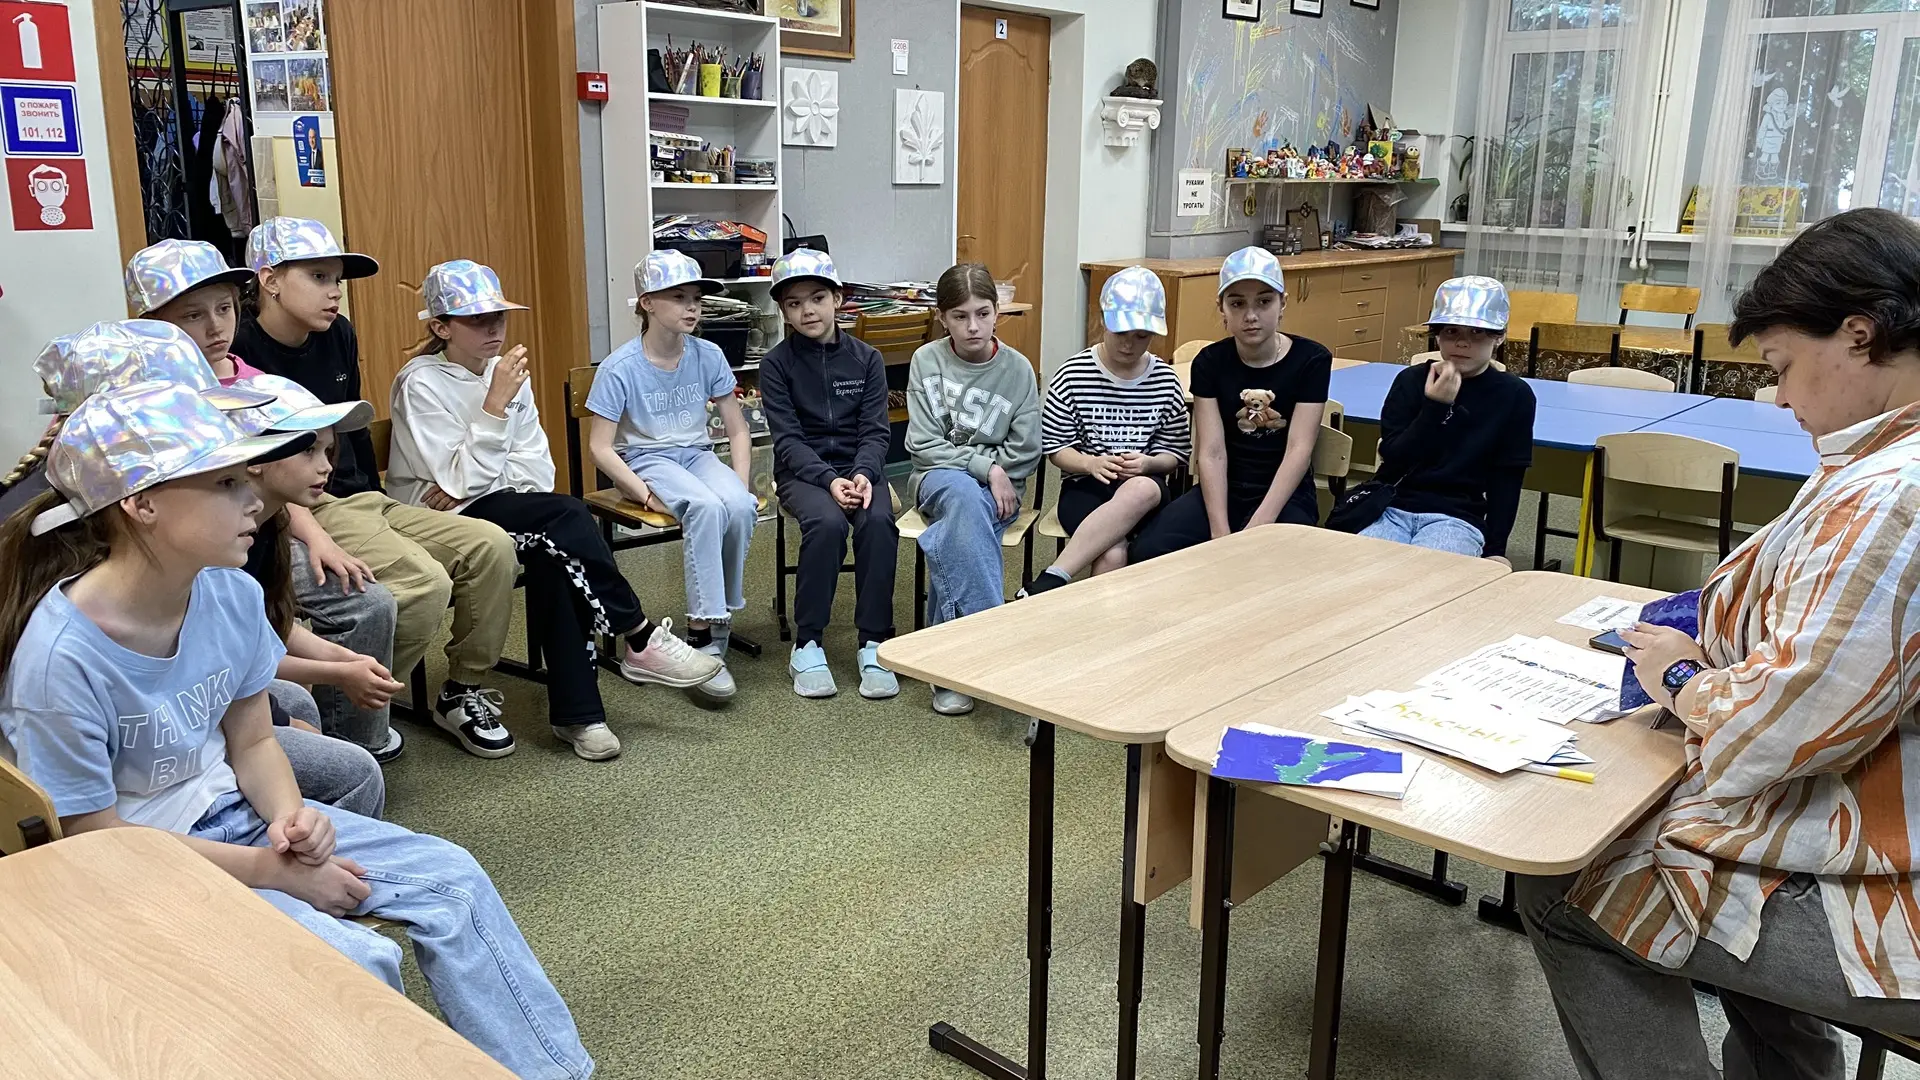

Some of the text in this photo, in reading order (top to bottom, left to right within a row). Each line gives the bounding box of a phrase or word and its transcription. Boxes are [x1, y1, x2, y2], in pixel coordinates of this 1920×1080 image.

[999, 23, 1005, 35] 2
[21, 110, 60, 118] ЗВОНИТЬ
[22, 127, 63, 139] 101, 112
[656, 409, 693, 433] BIG
[1091, 406, 1160, 422] PURE &
[1091, 424, 1148, 442] SIMPL
[147, 747, 198, 793] BI
